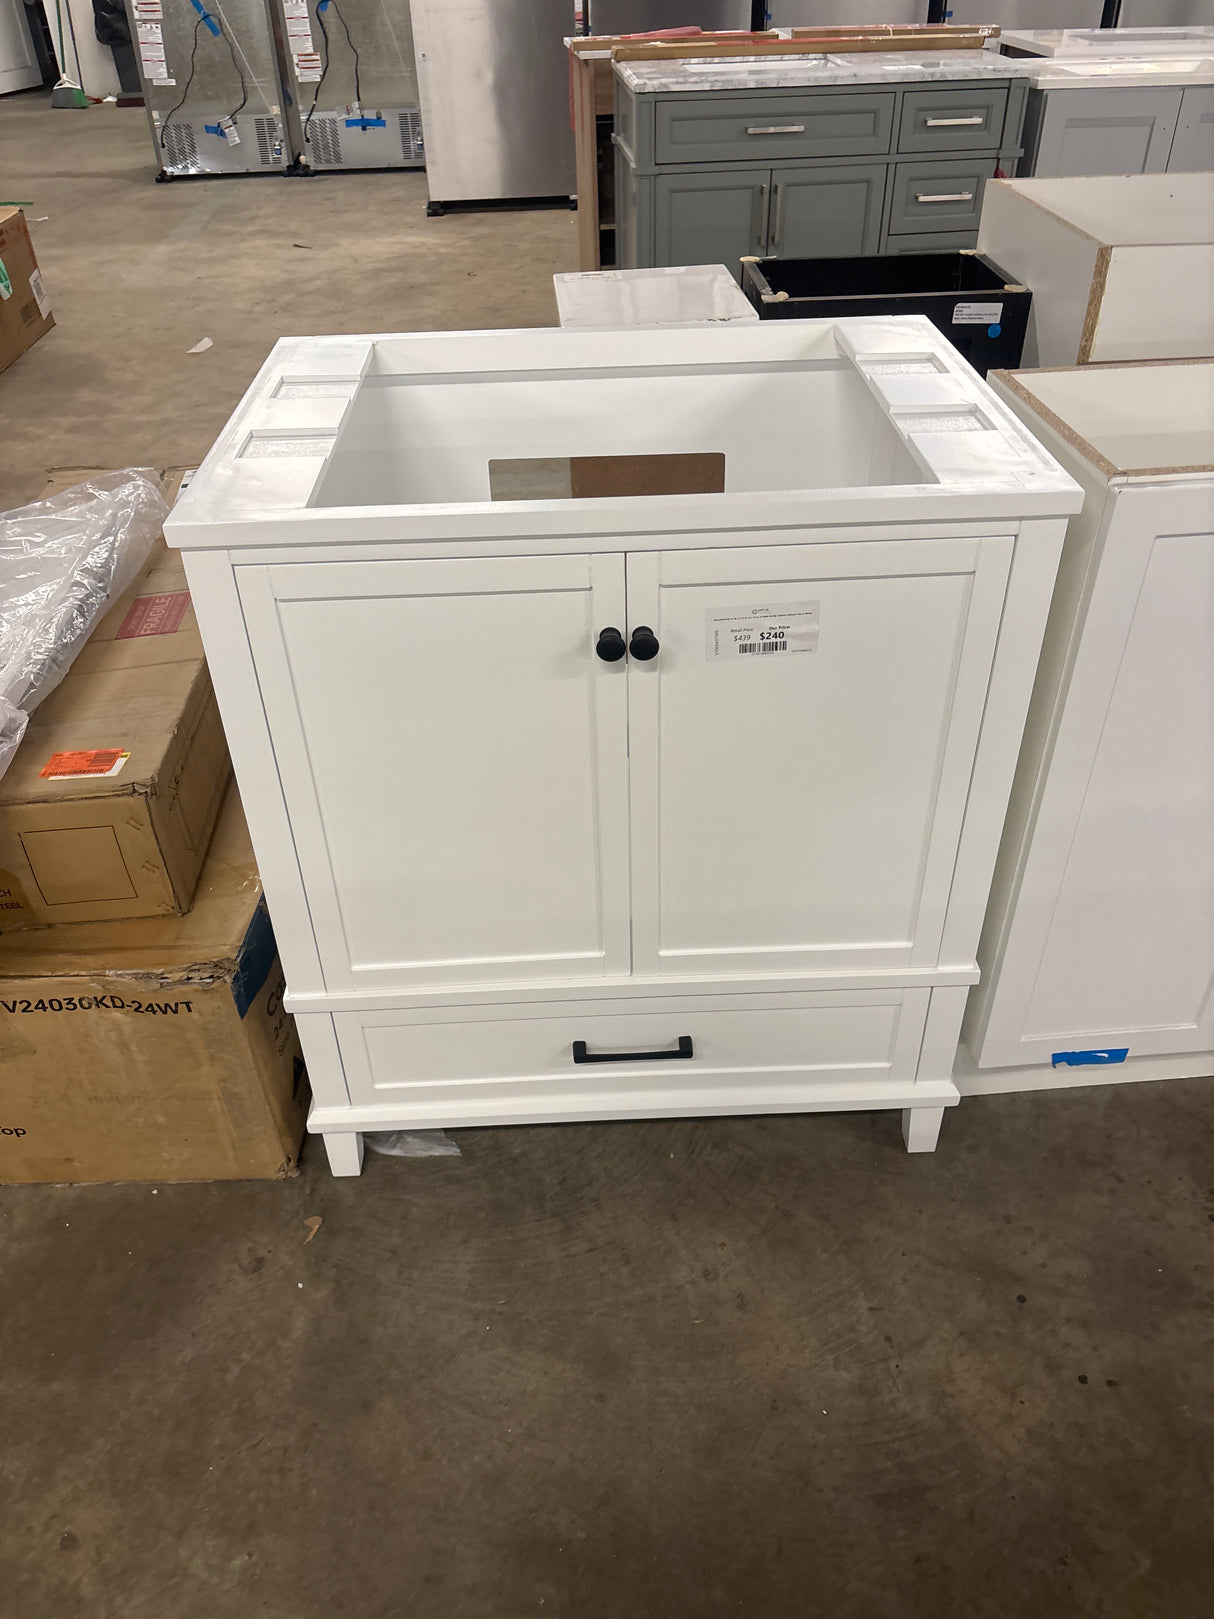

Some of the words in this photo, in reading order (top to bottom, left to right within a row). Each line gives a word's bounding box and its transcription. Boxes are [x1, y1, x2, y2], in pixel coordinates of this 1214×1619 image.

[140, 597, 171, 635] FRAGILE
[734, 634, 751, 642] $439
[759, 631, 785, 641] $240
[0, 1126, 27, 1138] op
